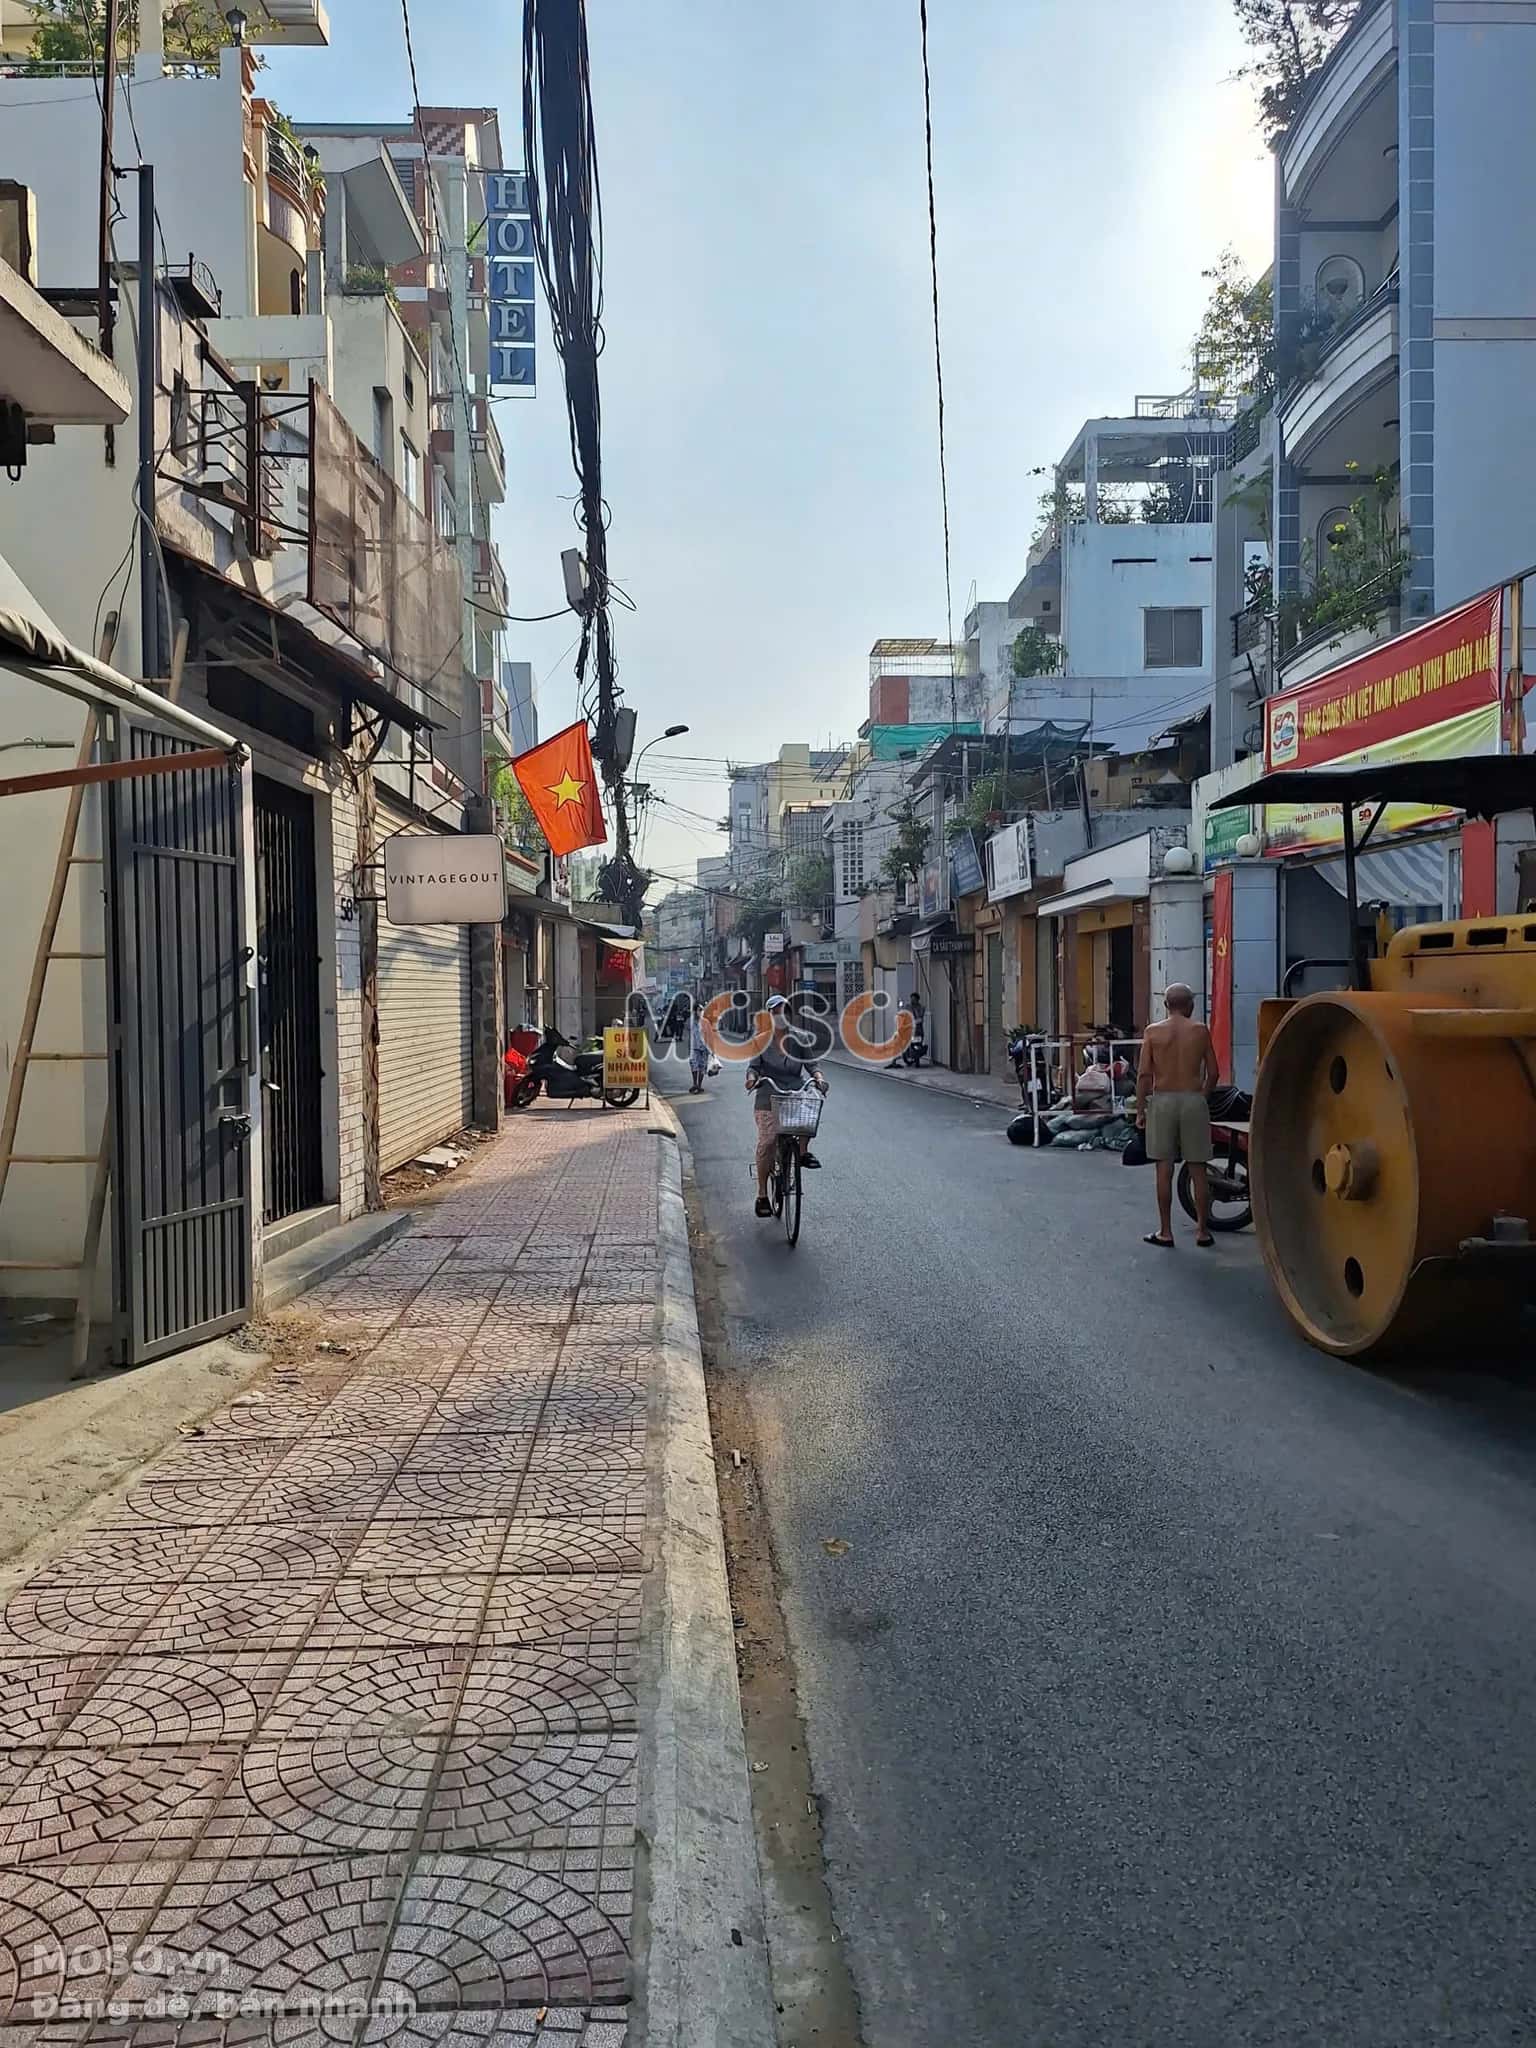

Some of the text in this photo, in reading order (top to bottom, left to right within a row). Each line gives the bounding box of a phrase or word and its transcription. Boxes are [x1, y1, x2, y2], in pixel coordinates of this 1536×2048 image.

[493, 175, 527, 382] HOTEL
[1357, 680, 1374, 723] VIỆT
[1374, 676, 1392, 713] NAM
[1393, 664, 1421, 708] QUANG
[1422, 655, 1443, 694] VINH
[1445, 638, 1473, 686] MUÔN
[388, 873, 499, 885] VINTAGEGOUT
[607, 1062, 646, 1072] NHANH
